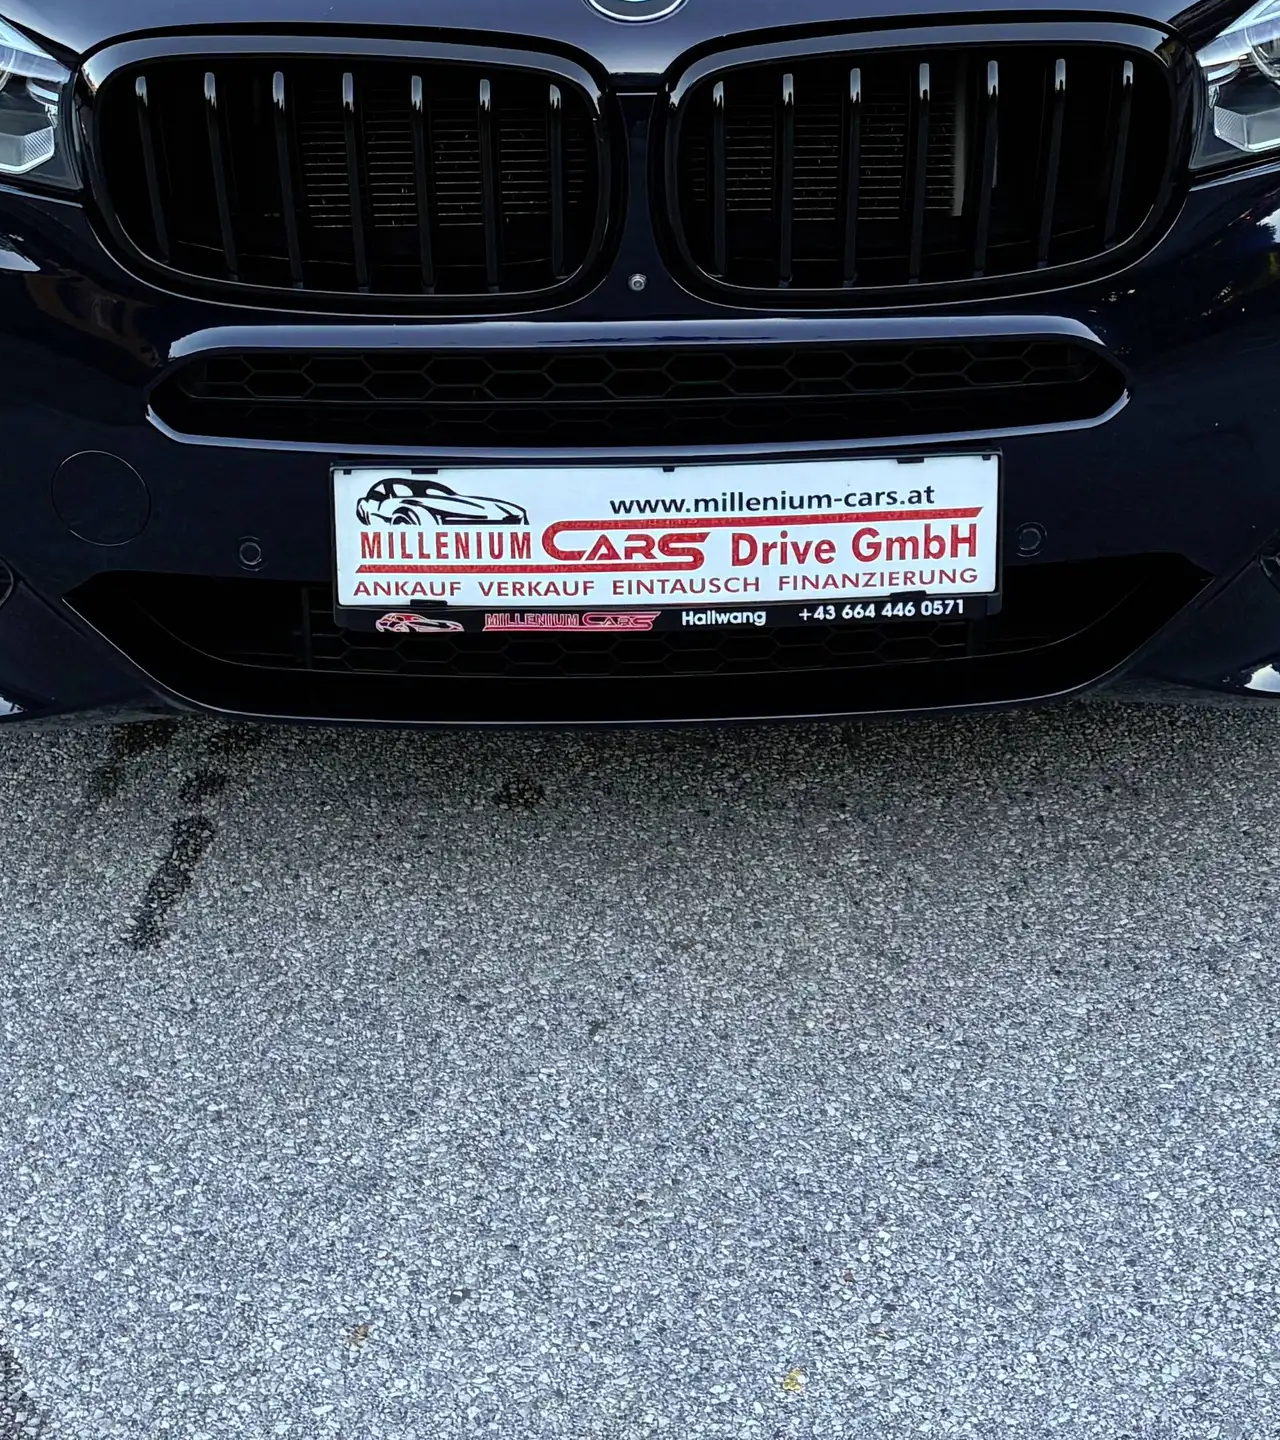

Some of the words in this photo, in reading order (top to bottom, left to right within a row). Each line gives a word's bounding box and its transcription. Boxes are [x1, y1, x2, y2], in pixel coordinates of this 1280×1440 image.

[609, 485, 936, 515] www.millenium-cars.at
[360, 531, 532, 561] MILLENIUM
[542, 520, 712, 569] CARS
[731, 530, 837, 568] Drive
[851, 523, 978, 562] GmbH
[352, 580, 462, 598] ANKAUF
[478, 579, 596, 597] VERKAUF
[612, 575, 760, 596] EINTAUSCH
[778, 567, 979, 593] FINANZIERUNG
[484, 612, 580, 627] MILLENIUM
[681, 610, 767, 627] Hallwang
[798, 606, 837, 622] +43
[841, 604, 875, 619] 664
[881, 602, 916, 618] 446
[920, 599, 964, 615] 0571
